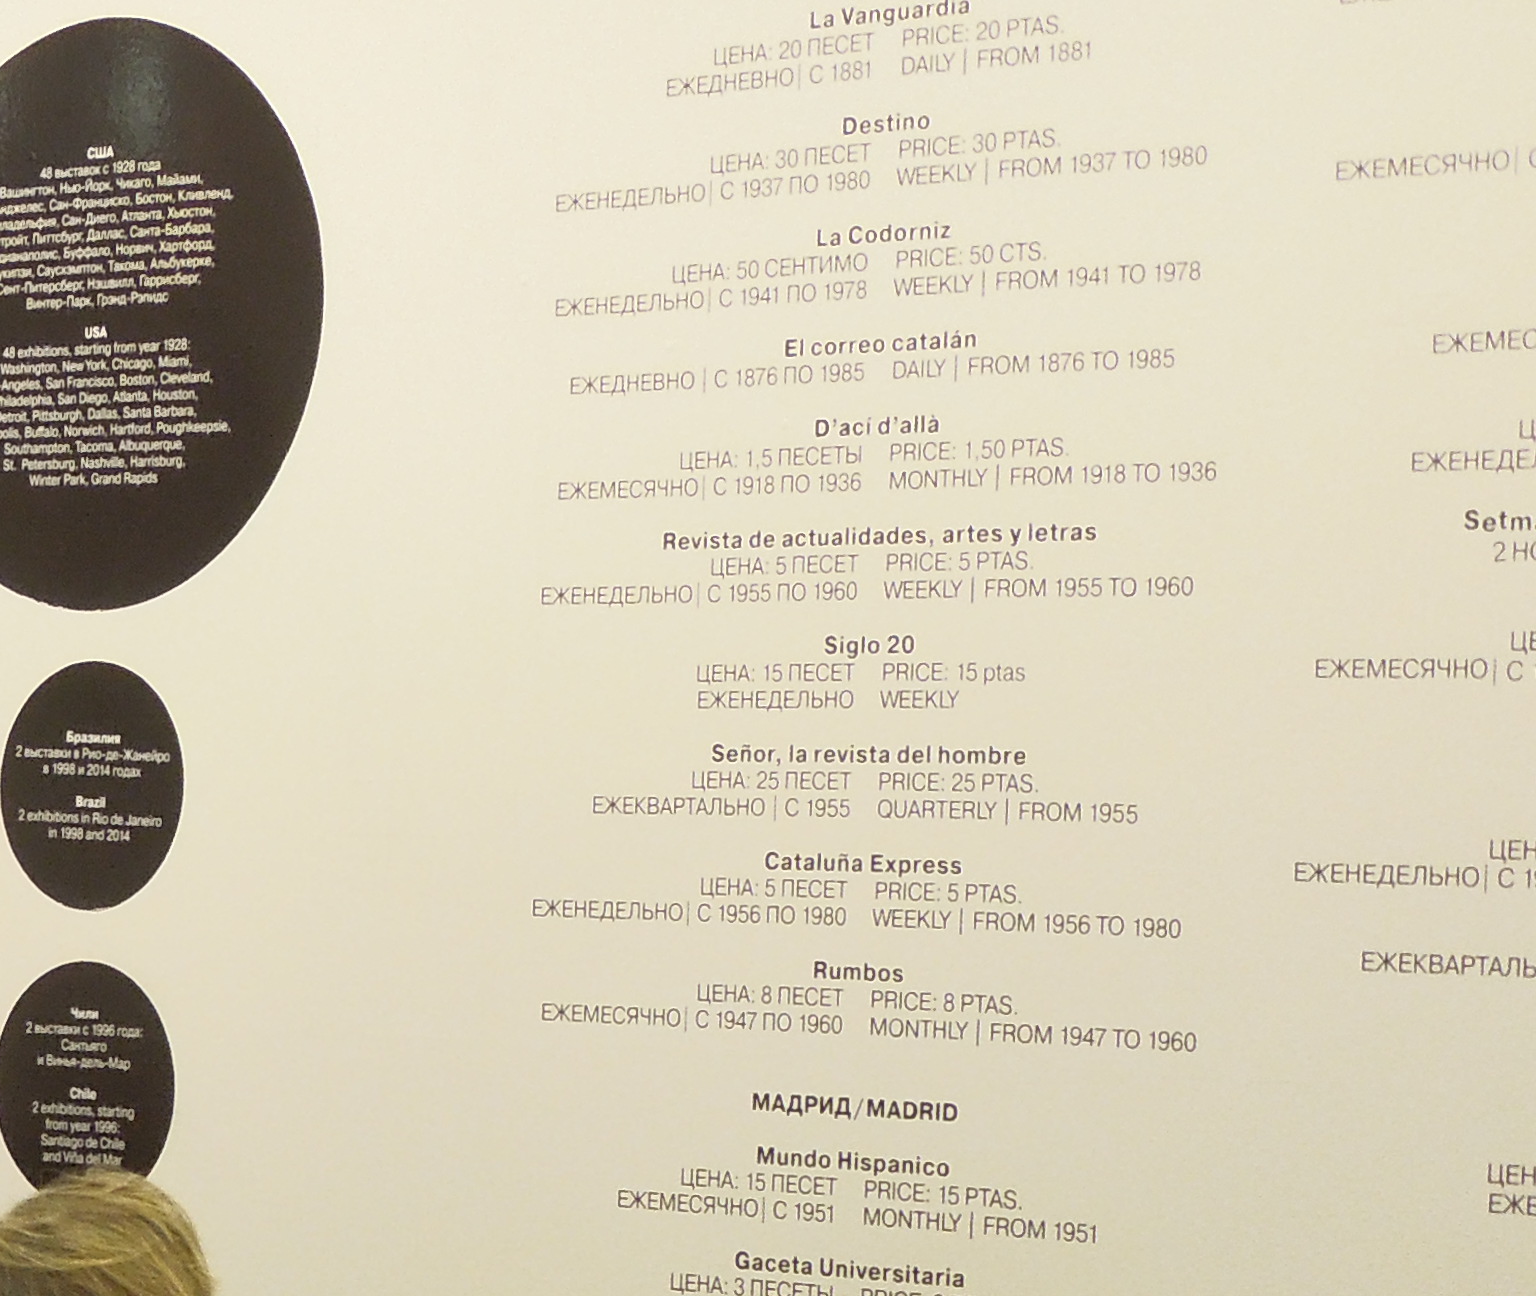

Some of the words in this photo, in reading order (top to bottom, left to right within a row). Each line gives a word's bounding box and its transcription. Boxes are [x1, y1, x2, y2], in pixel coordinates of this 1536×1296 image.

[809, 10, 834, 29] La
[840, 0, 969, 27] Vanguardia
[901, 23, 972, 47] PRICE:
[975, 19, 1001, 41] 20
[1005, 13, 1063, 38] PTAS.
[713, 42, 771, 68] ЦЕНА:
[778, 38, 802, 60] 20
[807, 31, 875, 56] ПЕСЕТ
[842, 112, 930, 135] Destino
[86, 145, 113, 159] США
[112, 159, 134, 173] 1928
[816, 228, 841, 247] La
[847, 220, 951, 244] Codorniz
[84, 326, 106, 338] USA
[784, 338, 804, 357] El
[810, 338, 885, 356] correo
[891, 329, 976, 352] catalán
[62, 360, 84, 371] New
[662, 530, 742, 550] Revista
[748, 529, 775, 548] de
[781, 525, 933, 548] actualidades,
[941, 524, 1003, 543] artes
[1009, 527, 1021, 547] y
[1027, 522, 1096, 542] letras
[823, 634, 880, 659] Siglo
[886, 634, 914, 654] 20
[696, 663, 755, 685] ЦЕНА:
[763, 662, 783, 682] 15
[788, 661, 855, 682] ПЕСЕТ
[881, 661, 947, 682] PRICE:
[957, 661, 977, 682] 15
[983, 663, 1025, 685] ptas
[697, 688, 854, 712] ЕЖЕНЕДЕЛЬНО
[879, 689, 959, 709] WEEKLY
[711, 743, 781, 766] Señor,
[788, 743, 807, 763] la
[813, 744, 889, 763] revista
[896, 744, 931, 764] del
[937, 745, 1026, 765] hombre
[75, 795, 105, 807] Brazil
[48, 827, 56, 837] in
[60, 826, 82, 839] 1998
[85, 829, 104, 840] and
[106, 829, 129, 841] 2014
[764, 850, 863, 872] Cataluña
[869, 853, 961, 878] Express
[813, 960, 903, 983] Rumbos
[69, 1087, 96, 1099] Chile
[45, 1118, 67, 1130] from
[70, 1122, 90, 1133] year
[756, 1145, 831, 1169] Mundo
[837, 1150, 949, 1177] Hispanico
[734, 1250, 812, 1275] Gaceta
[819, 1256, 964, 1288] Universitaria
